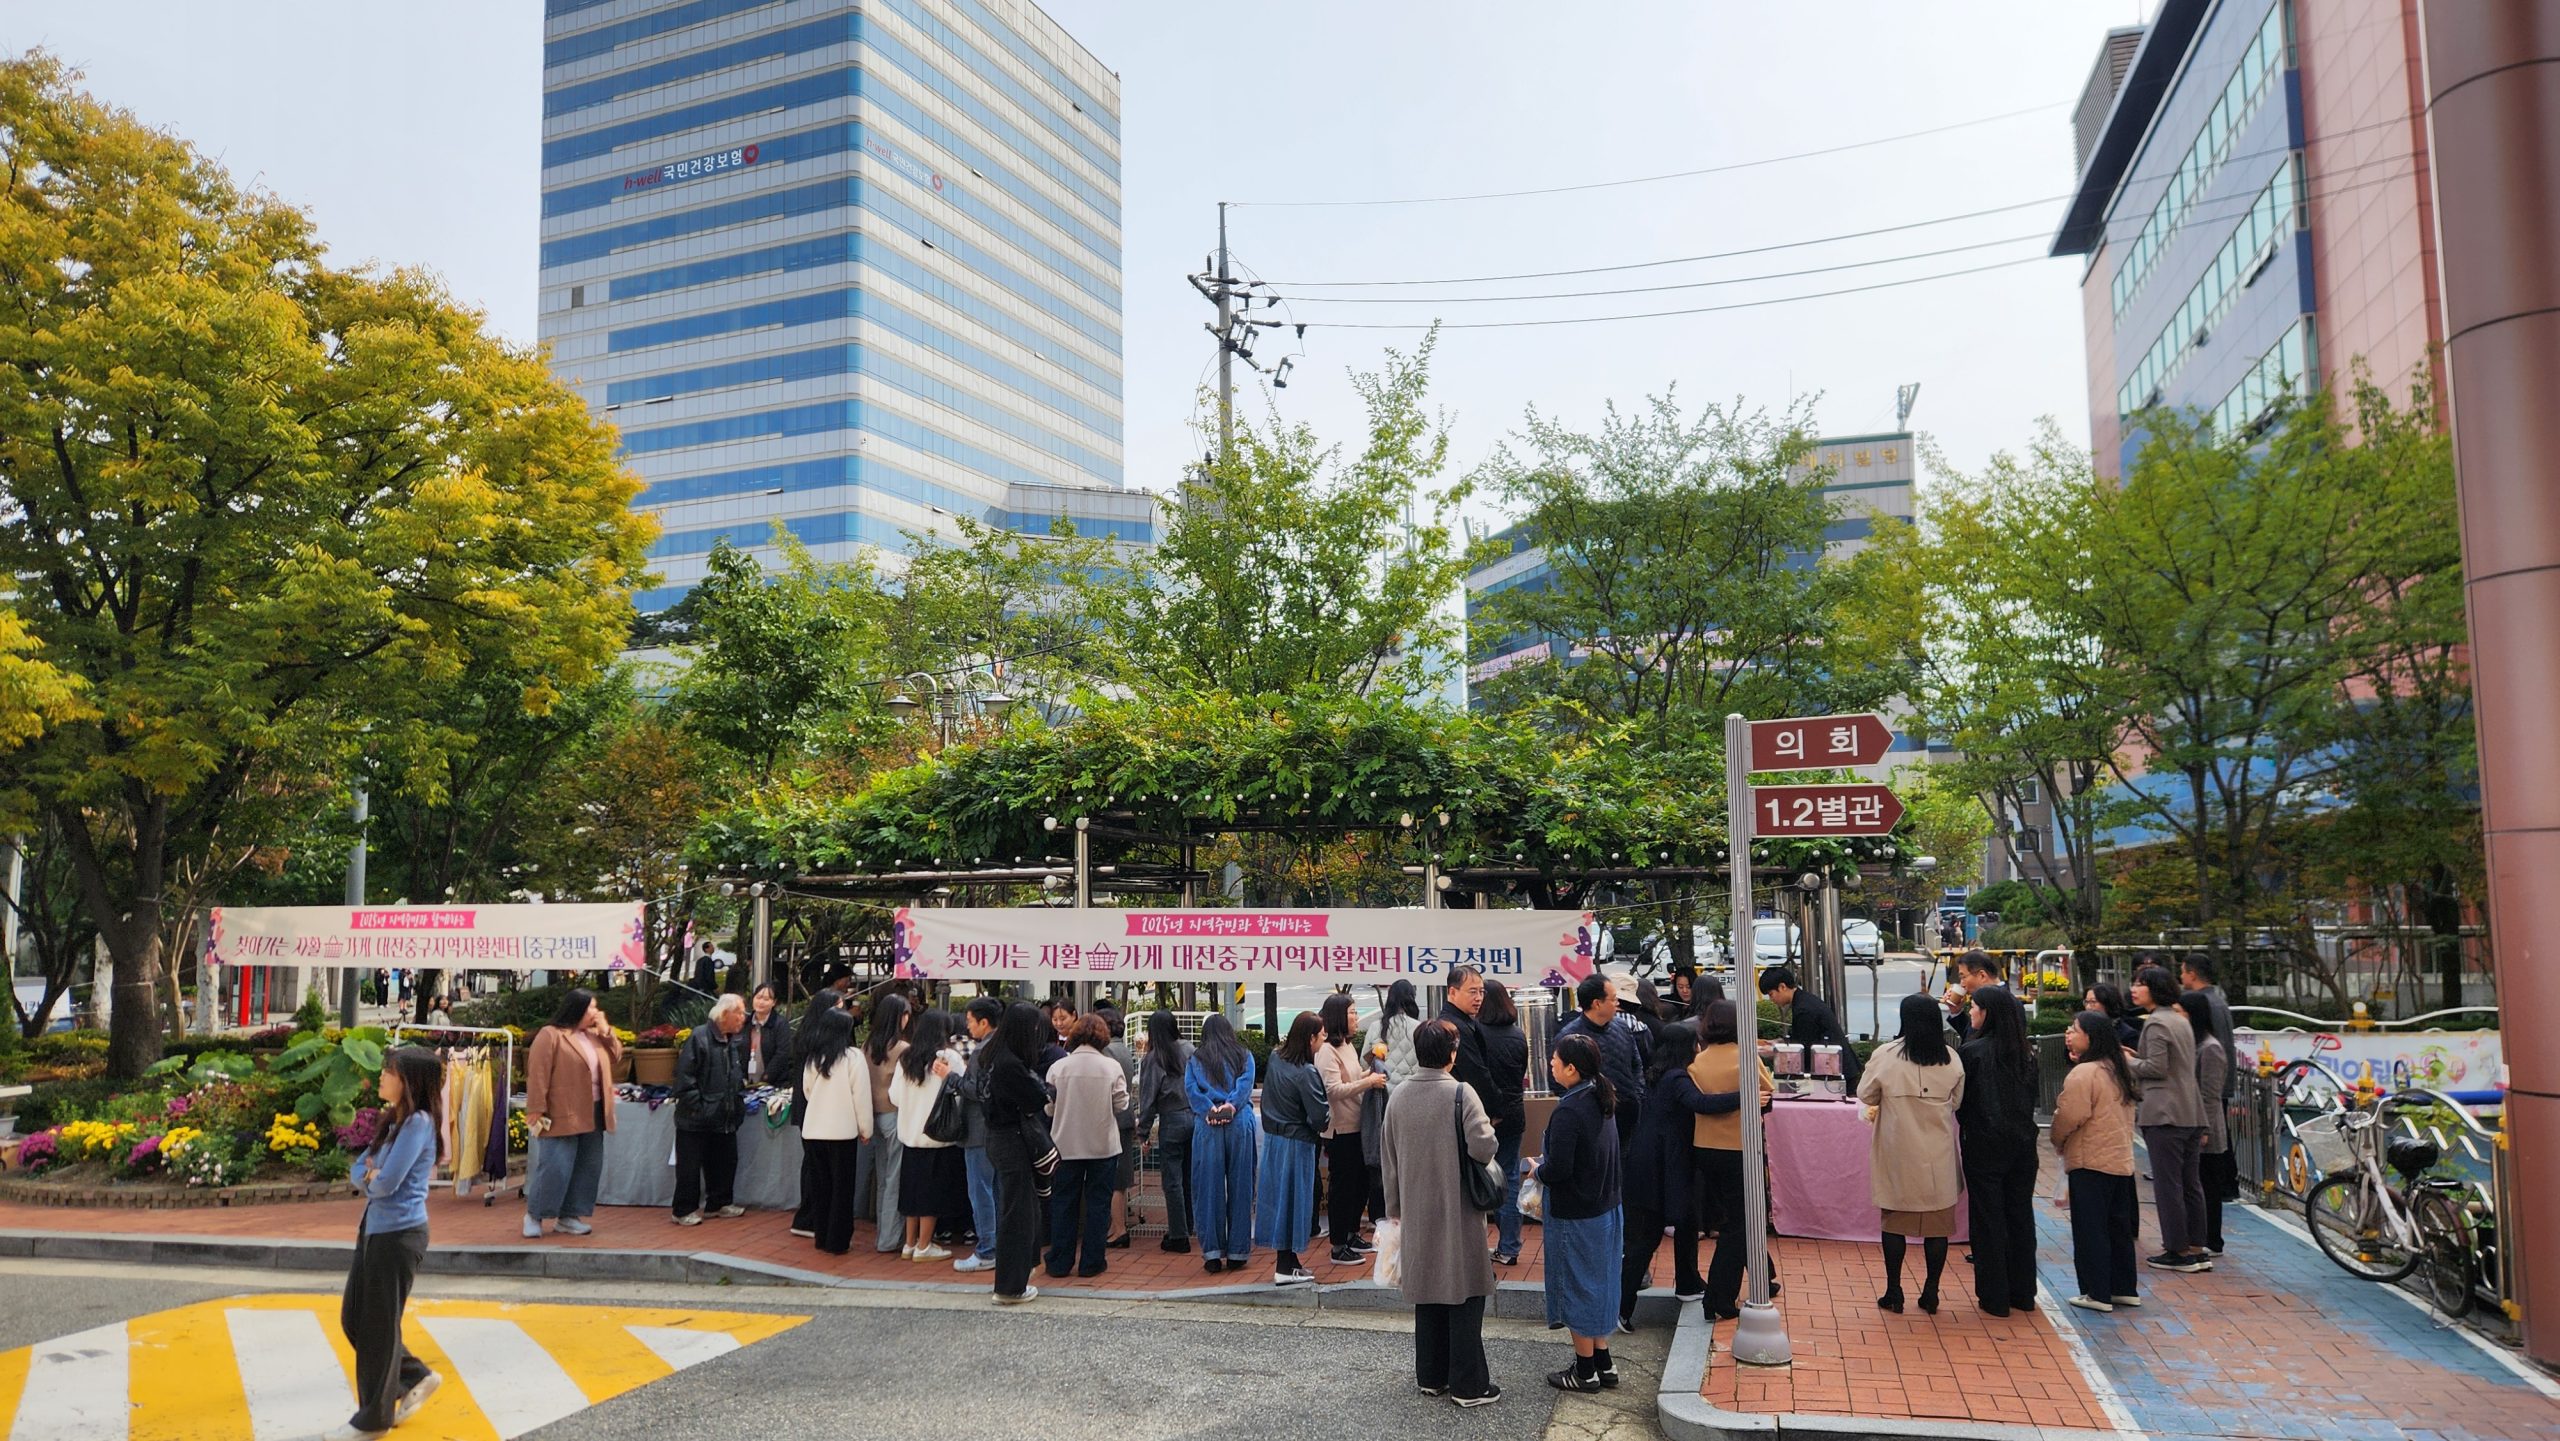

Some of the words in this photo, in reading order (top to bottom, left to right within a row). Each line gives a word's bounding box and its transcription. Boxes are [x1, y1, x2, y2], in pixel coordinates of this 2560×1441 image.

[663, 149, 742, 180] 국민건강보험
[1764, 795, 1884, 827] 1.2별관
[360, 912, 386, 928] 2025년
[1142, 916, 1183, 933] 2025년
[1189, 916, 1252, 935] 지역주민과
[1257, 915, 1312, 934] 함께하는
[234, 936, 289, 959] 찾아가는
[294, 936, 321, 959] 자활
[344, 936, 371, 959] 가게
[947, 943, 1030, 970] 찾아가는
[1039, 943, 1082, 970] 자활
[1120, 944, 1163, 971] 가게
